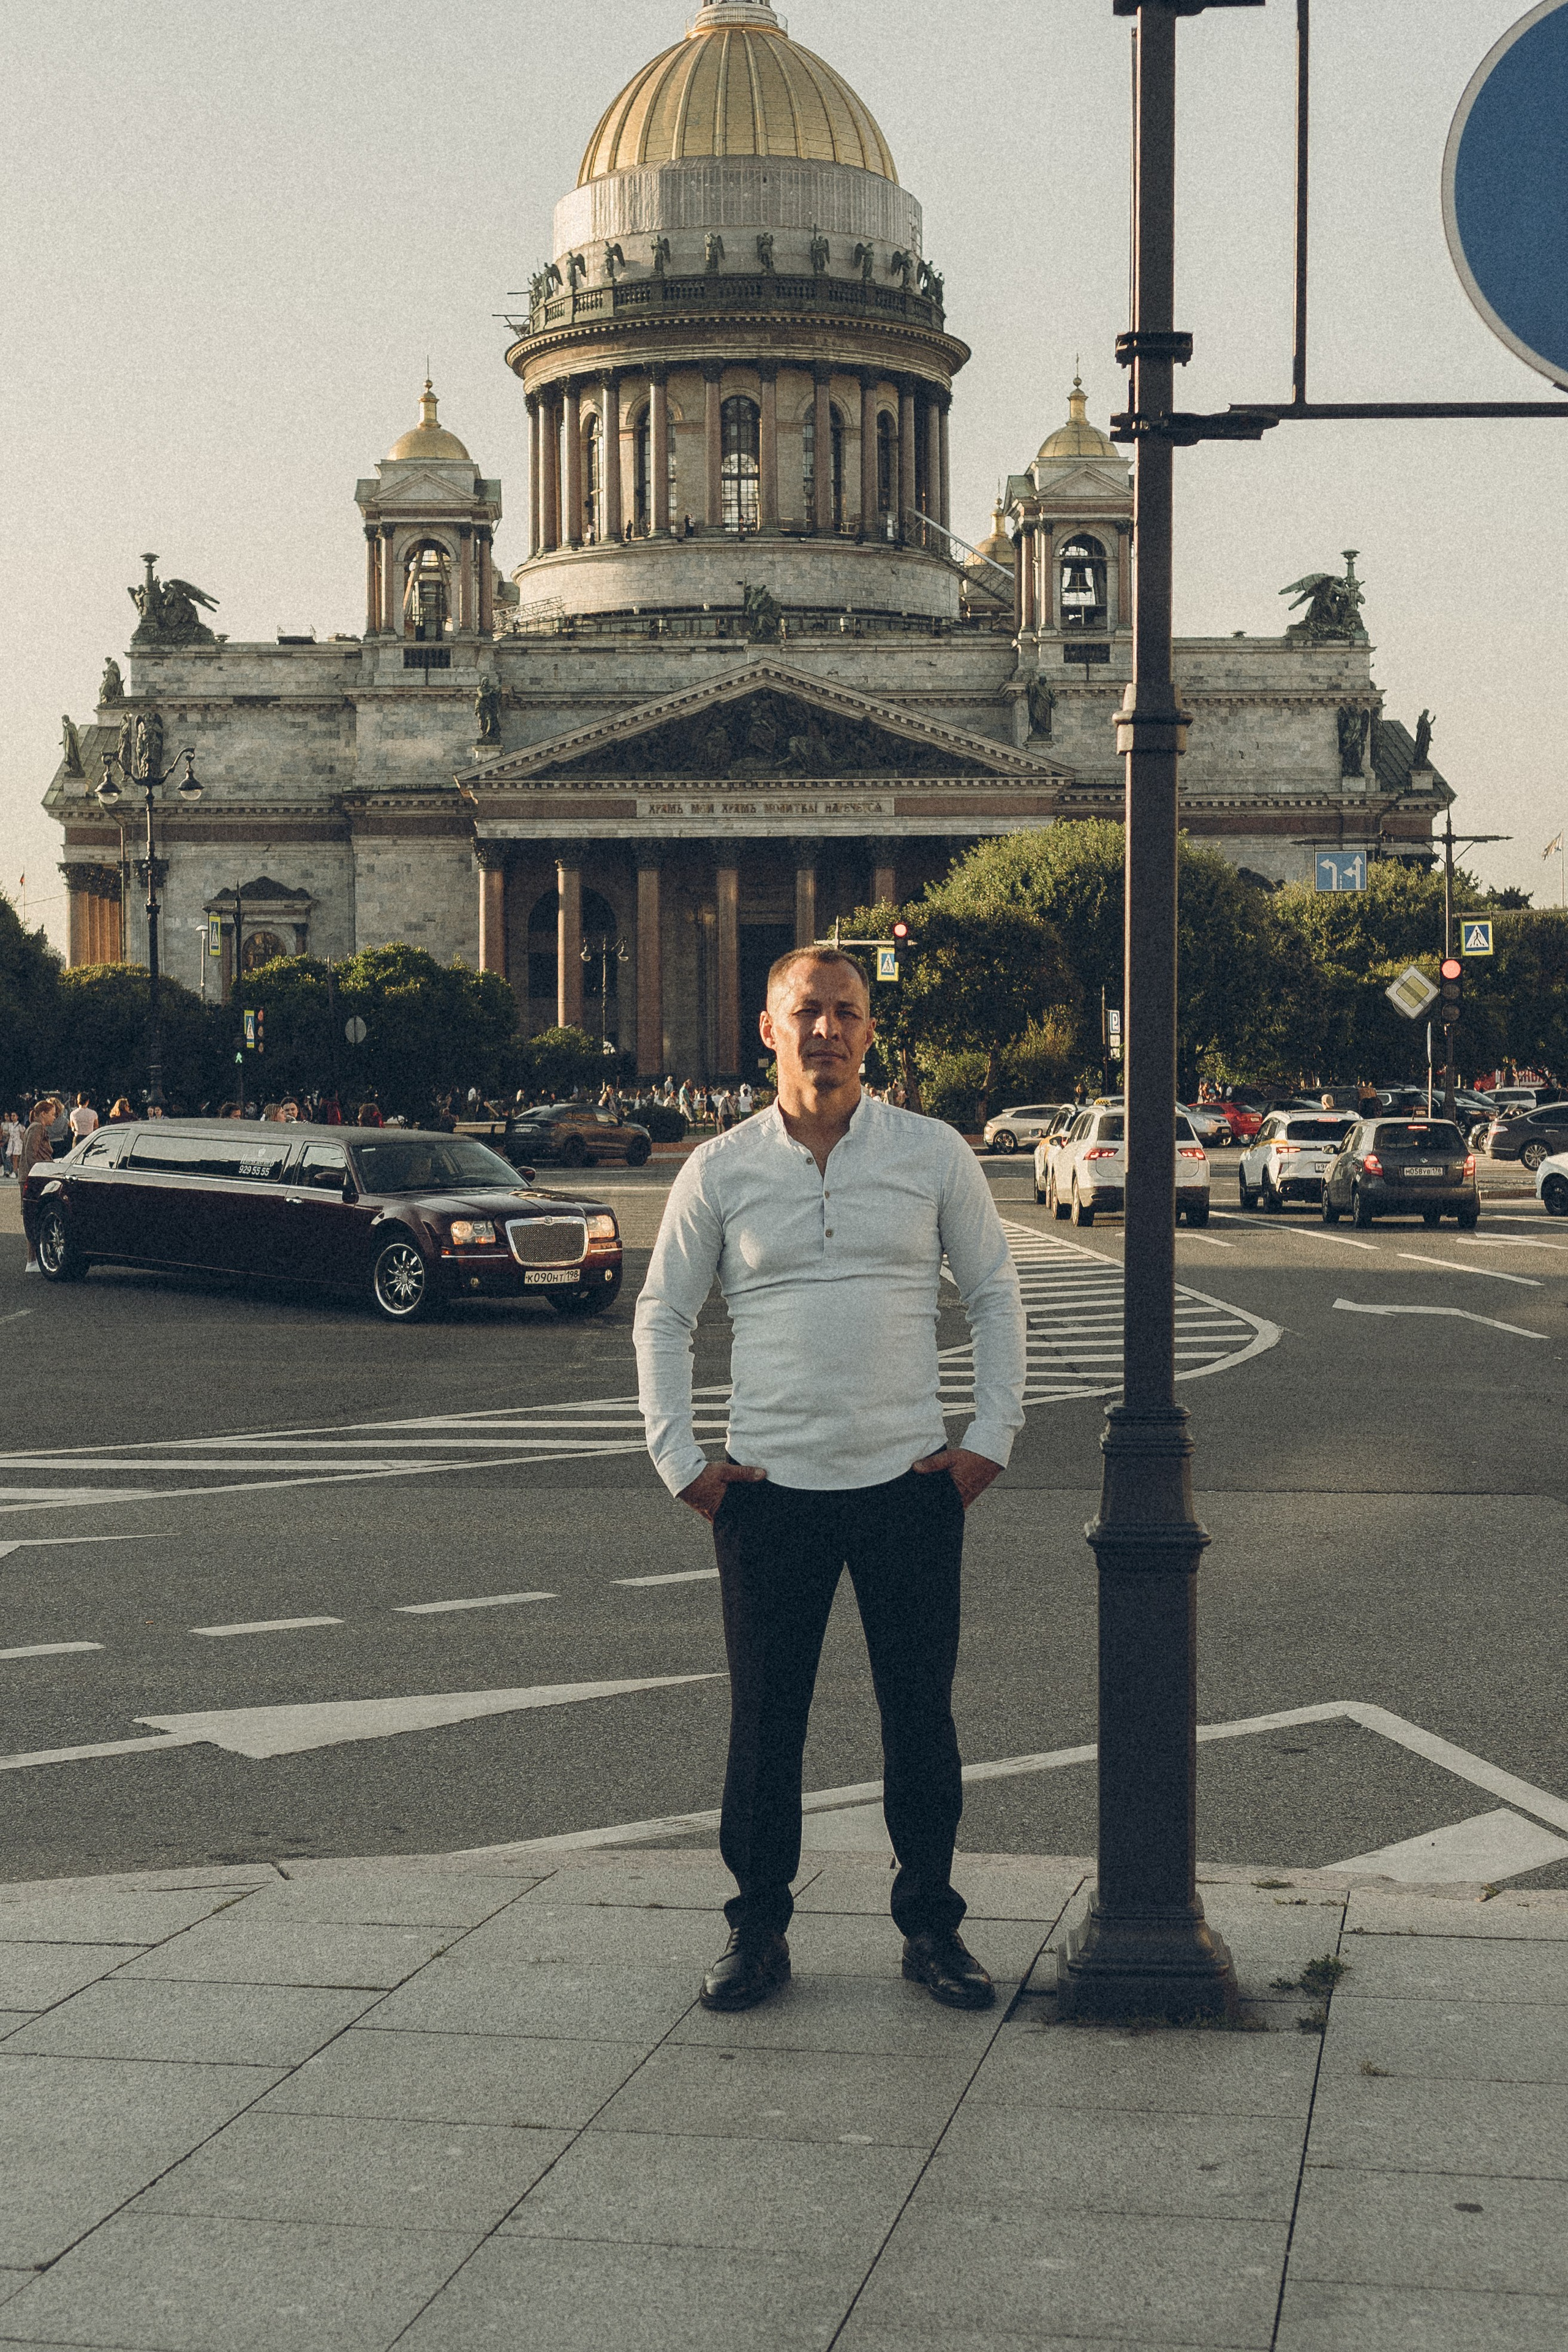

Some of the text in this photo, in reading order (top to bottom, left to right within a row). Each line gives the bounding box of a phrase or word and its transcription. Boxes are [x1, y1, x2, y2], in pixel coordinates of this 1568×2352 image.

[238, 1165, 271, 1176] 929 55 55
[527, 1270, 579, 1283] К090НТ 198
